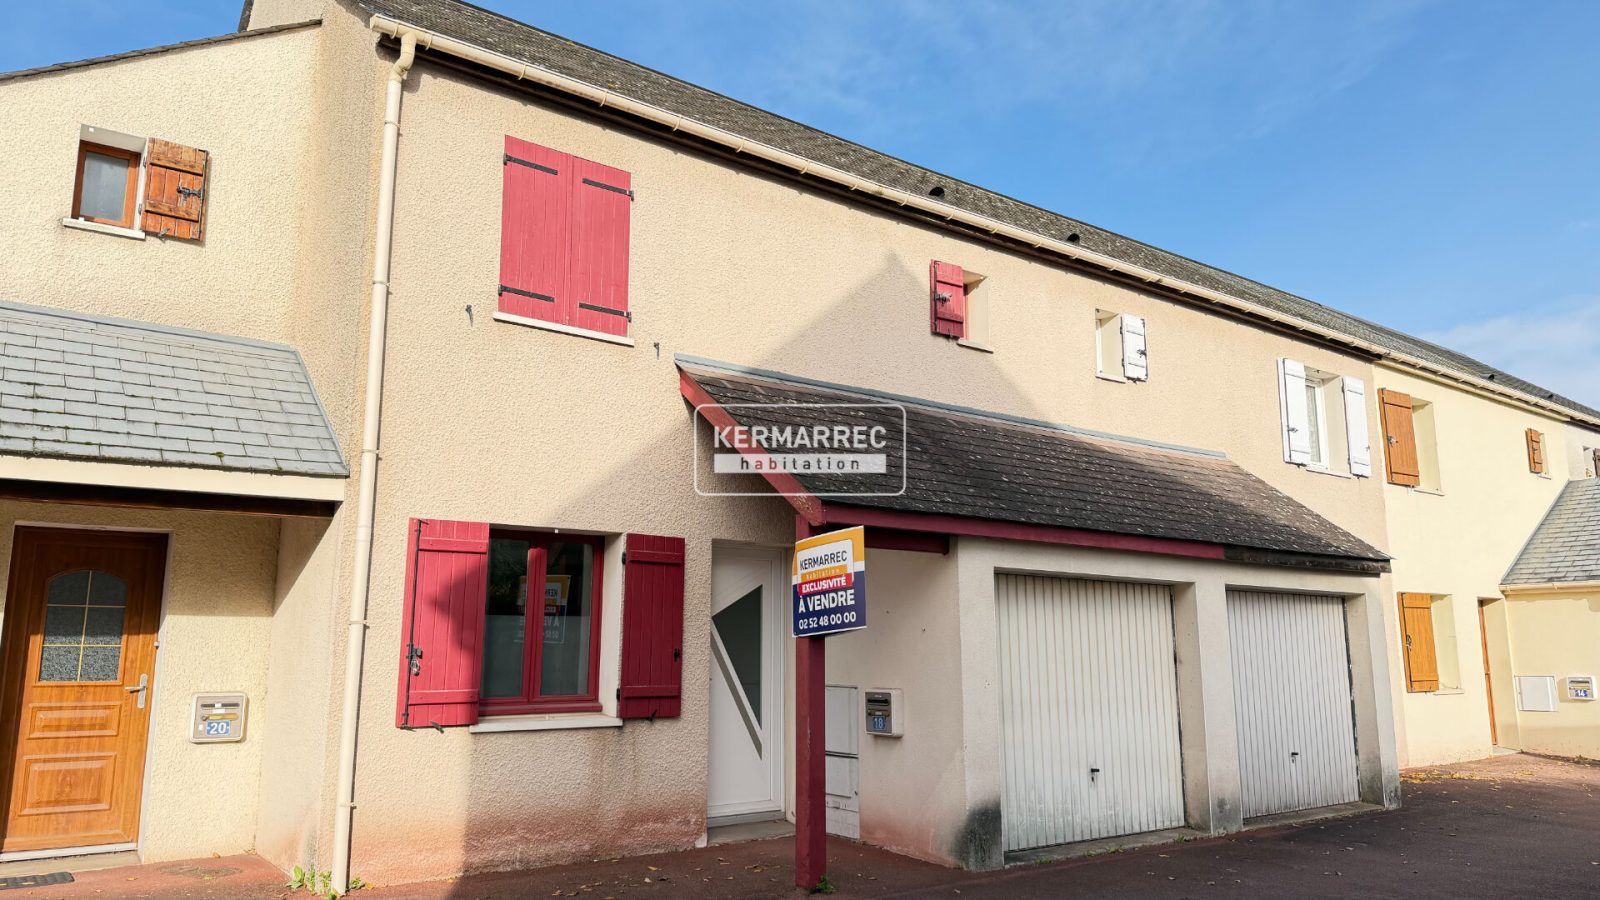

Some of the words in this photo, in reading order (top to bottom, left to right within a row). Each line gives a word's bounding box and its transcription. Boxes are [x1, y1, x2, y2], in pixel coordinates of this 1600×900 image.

[800, 551, 847, 571] KERMARREC
[802, 575, 847, 593] EXCLUSIVITÉ
[799, 595, 806, 613] À
[807, 589, 855, 612] VENDRE
[799, 619, 808, 630] 02
[809, 617, 818, 628] 52
[819, 615, 829, 626] 48
[830, 613, 842, 625] 00
[843, 611, 857, 623] 00
[210, 722, 227, 734] 20
[874, 717, 884, 729] 18
